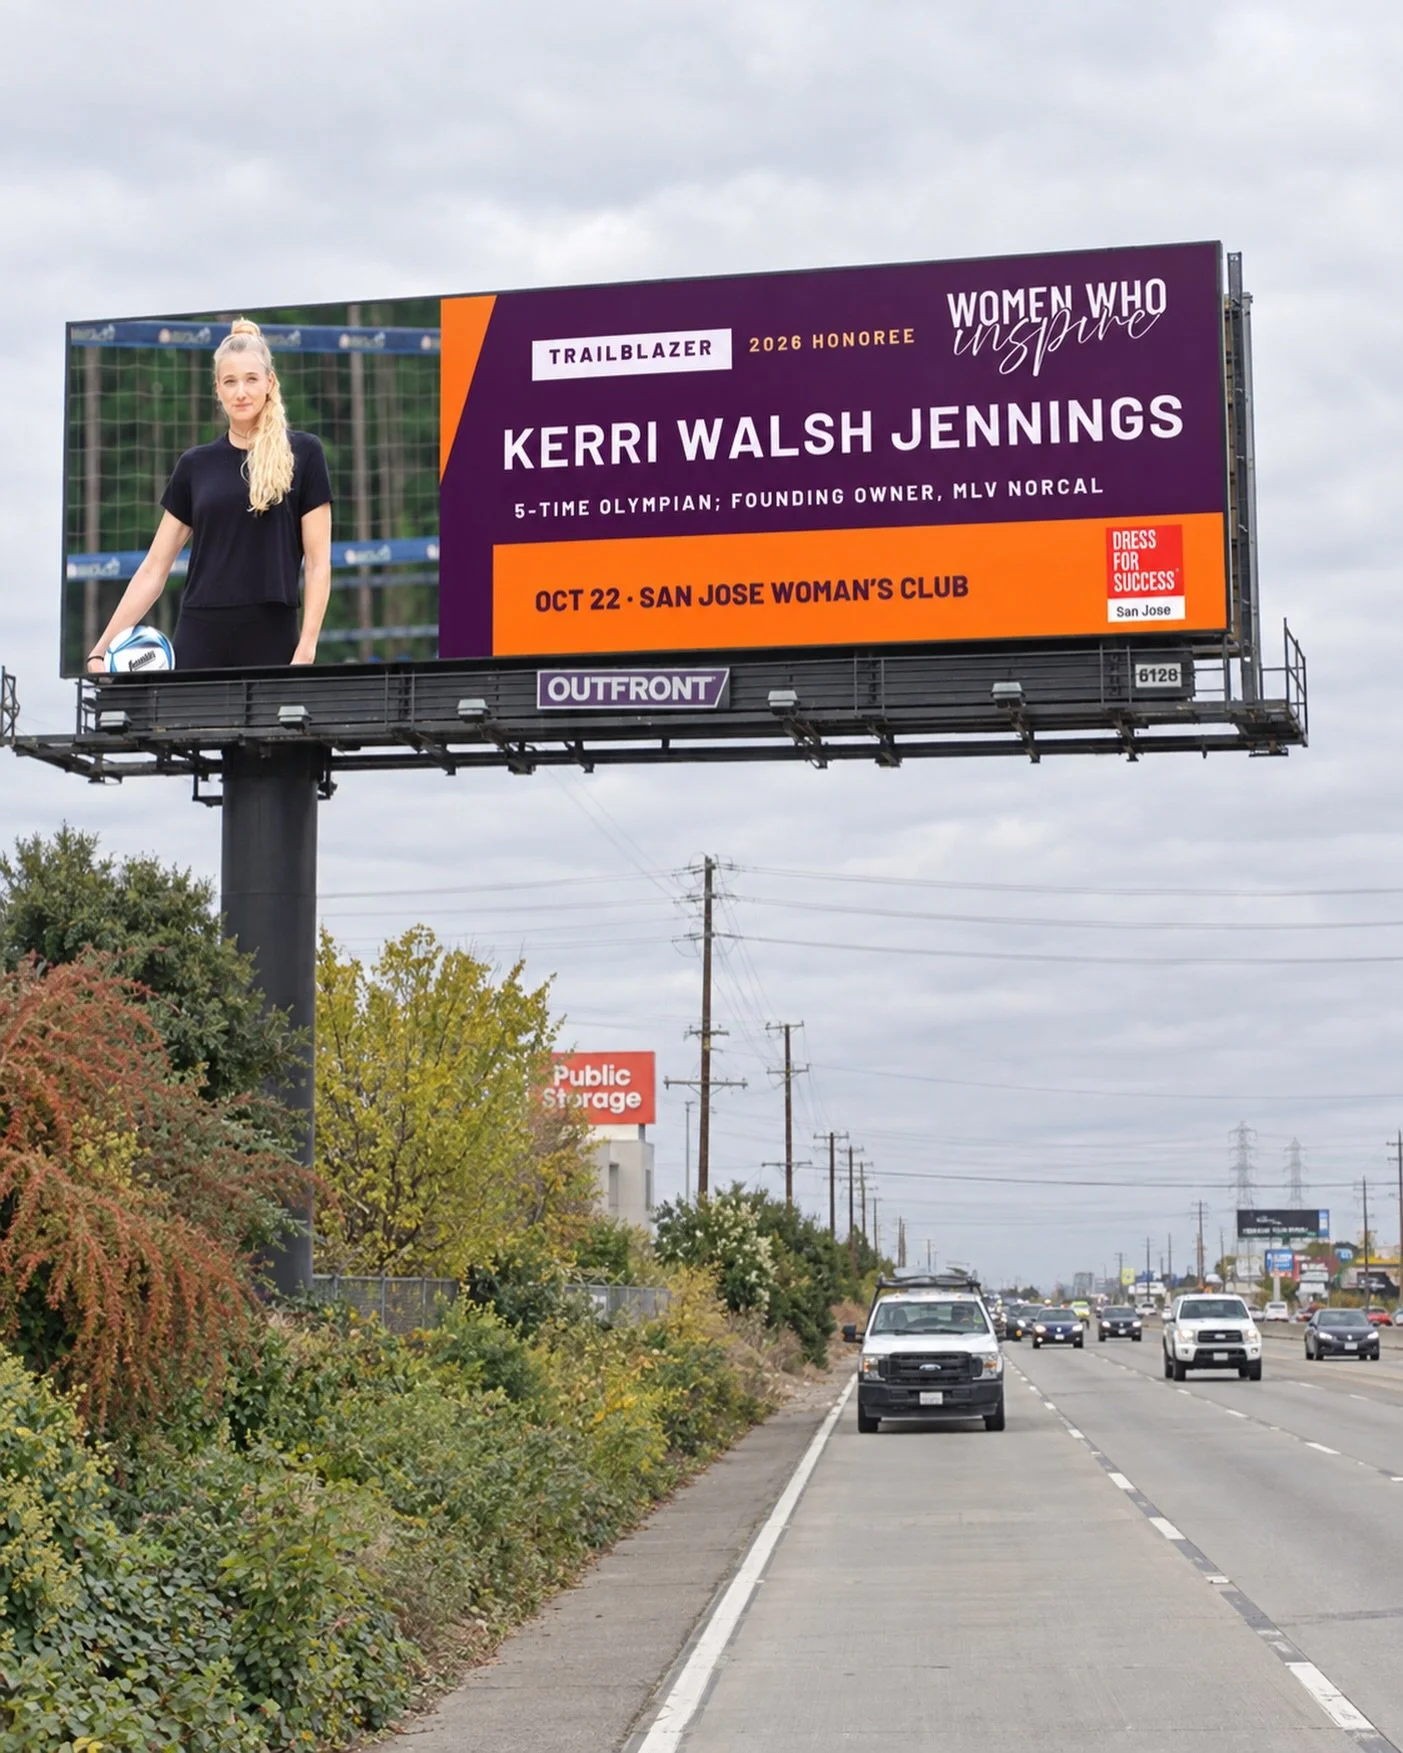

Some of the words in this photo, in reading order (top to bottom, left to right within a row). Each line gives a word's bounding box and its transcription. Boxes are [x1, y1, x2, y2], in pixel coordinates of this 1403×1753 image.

[947, 285, 1072, 328] WOMEN
[1086, 278, 1167, 318] WHO
[549, 340, 712, 364] TRAILBLAZER
[749, 336, 802, 352] 2026
[812, 329, 914, 348] HONOREE
[953, 305, 1161, 376] inspire
[504, 421, 657, 470] KERRI
[677, 411, 872, 461] WALSH
[891, 395, 1183, 451] JENNINGS
[515, 500, 590, 518] 5-TIME
[600, 494, 721, 514] OLYMPIAN;
[731, 488, 844, 508] FOUNDING
[855, 484, 942, 503] OWNER,
[953, 482, 997, 499] MLV
[1008, 478, 1103, 496] NORCAL
[1113, 530, 1157, 550] DRESS
[1113, 552, 1139, 571] FOR
[1113, 571, 1175, 592] SUCCESS
[535, 590, 583, 612] OCT
[590, 588, 621, 610] 22
[639, 586, 692, 608] SAN
[698, 582, 764, 606] JOSE
[771, 577, 894, 604] WOMAN’S
[900, 575, 969, 599] CLUB
[1116, 605, 1139, 617] San
[1142, 604, 1171, 616] Jose
[1138, 668, 1179, 682] 6128
[547, 675, 713, 702] OUTFRONT
[553, 1064, 632, 1086] Public
